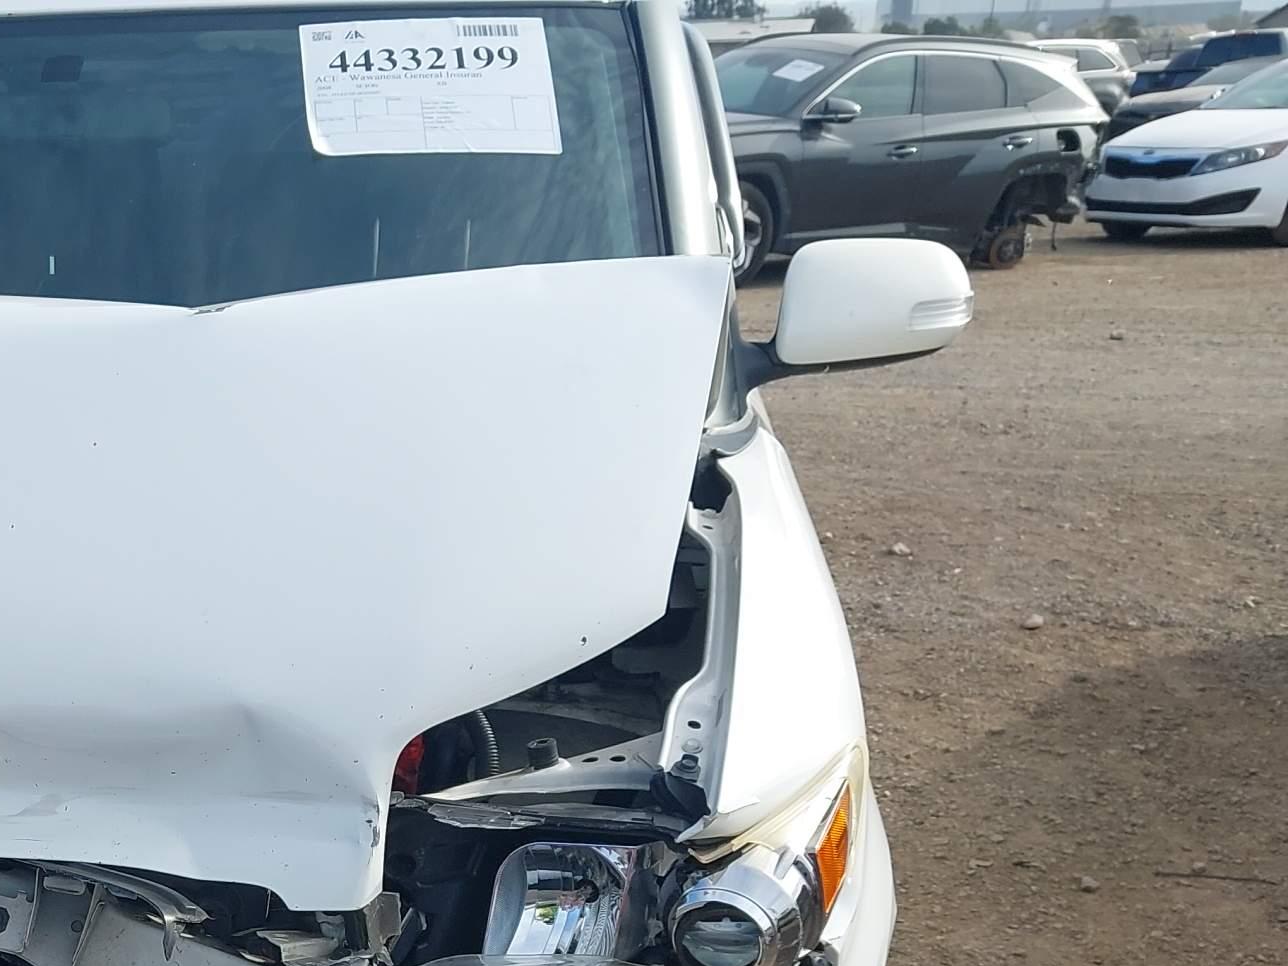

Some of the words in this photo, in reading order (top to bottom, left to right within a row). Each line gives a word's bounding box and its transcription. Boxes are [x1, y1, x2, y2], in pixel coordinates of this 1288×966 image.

[328, 45, 519, 73] 44332199
[349, 73, 402, 81] Wawanesa
[404, 71, 443, 79] General
